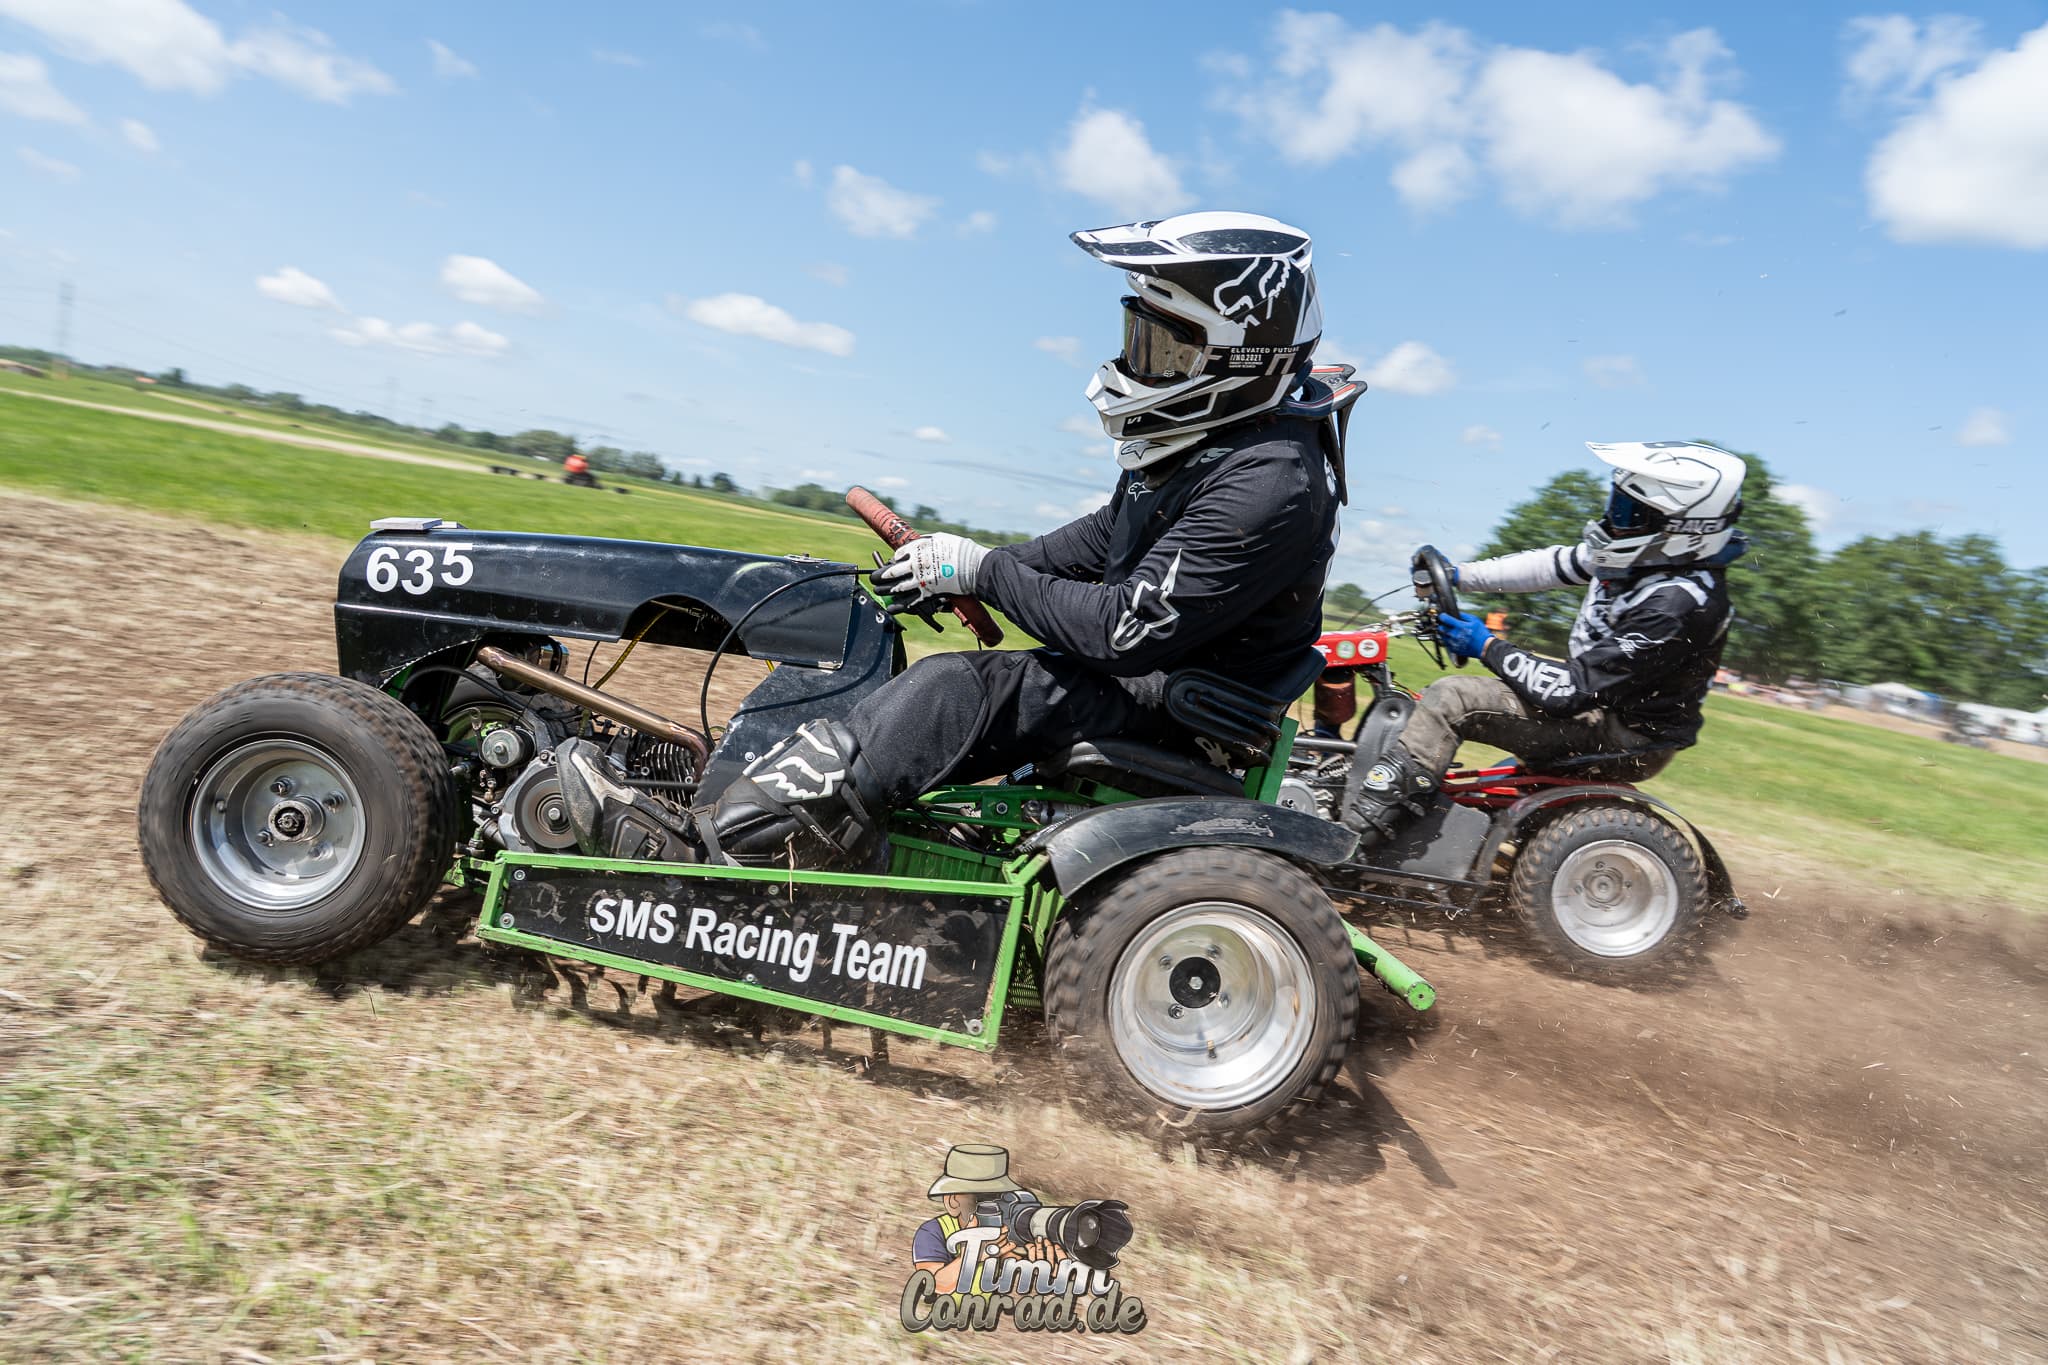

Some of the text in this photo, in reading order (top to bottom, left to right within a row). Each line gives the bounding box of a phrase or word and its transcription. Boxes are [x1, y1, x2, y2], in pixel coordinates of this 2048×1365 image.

[365, 542, 474, 596] 635
[589, 897, 927, 991] SMS Racing Team
